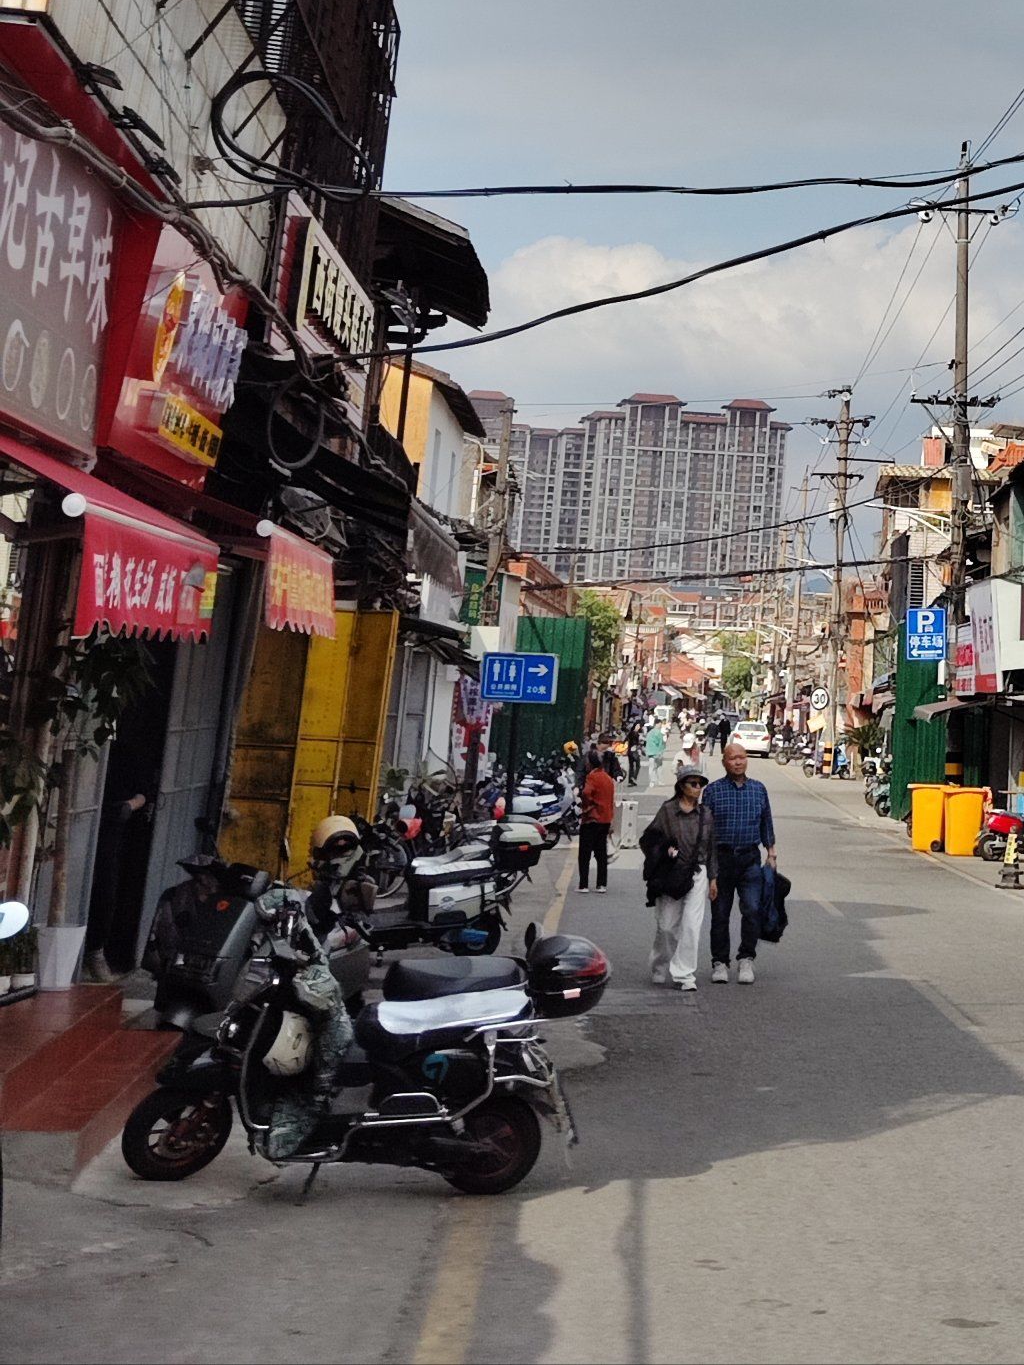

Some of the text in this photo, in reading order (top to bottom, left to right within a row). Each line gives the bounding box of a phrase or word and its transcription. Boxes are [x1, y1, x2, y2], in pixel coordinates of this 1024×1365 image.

[917, 611, 936, 633] P
[909, 635, 943, 648] 停车场
[814, 693, 825, 704] 30
